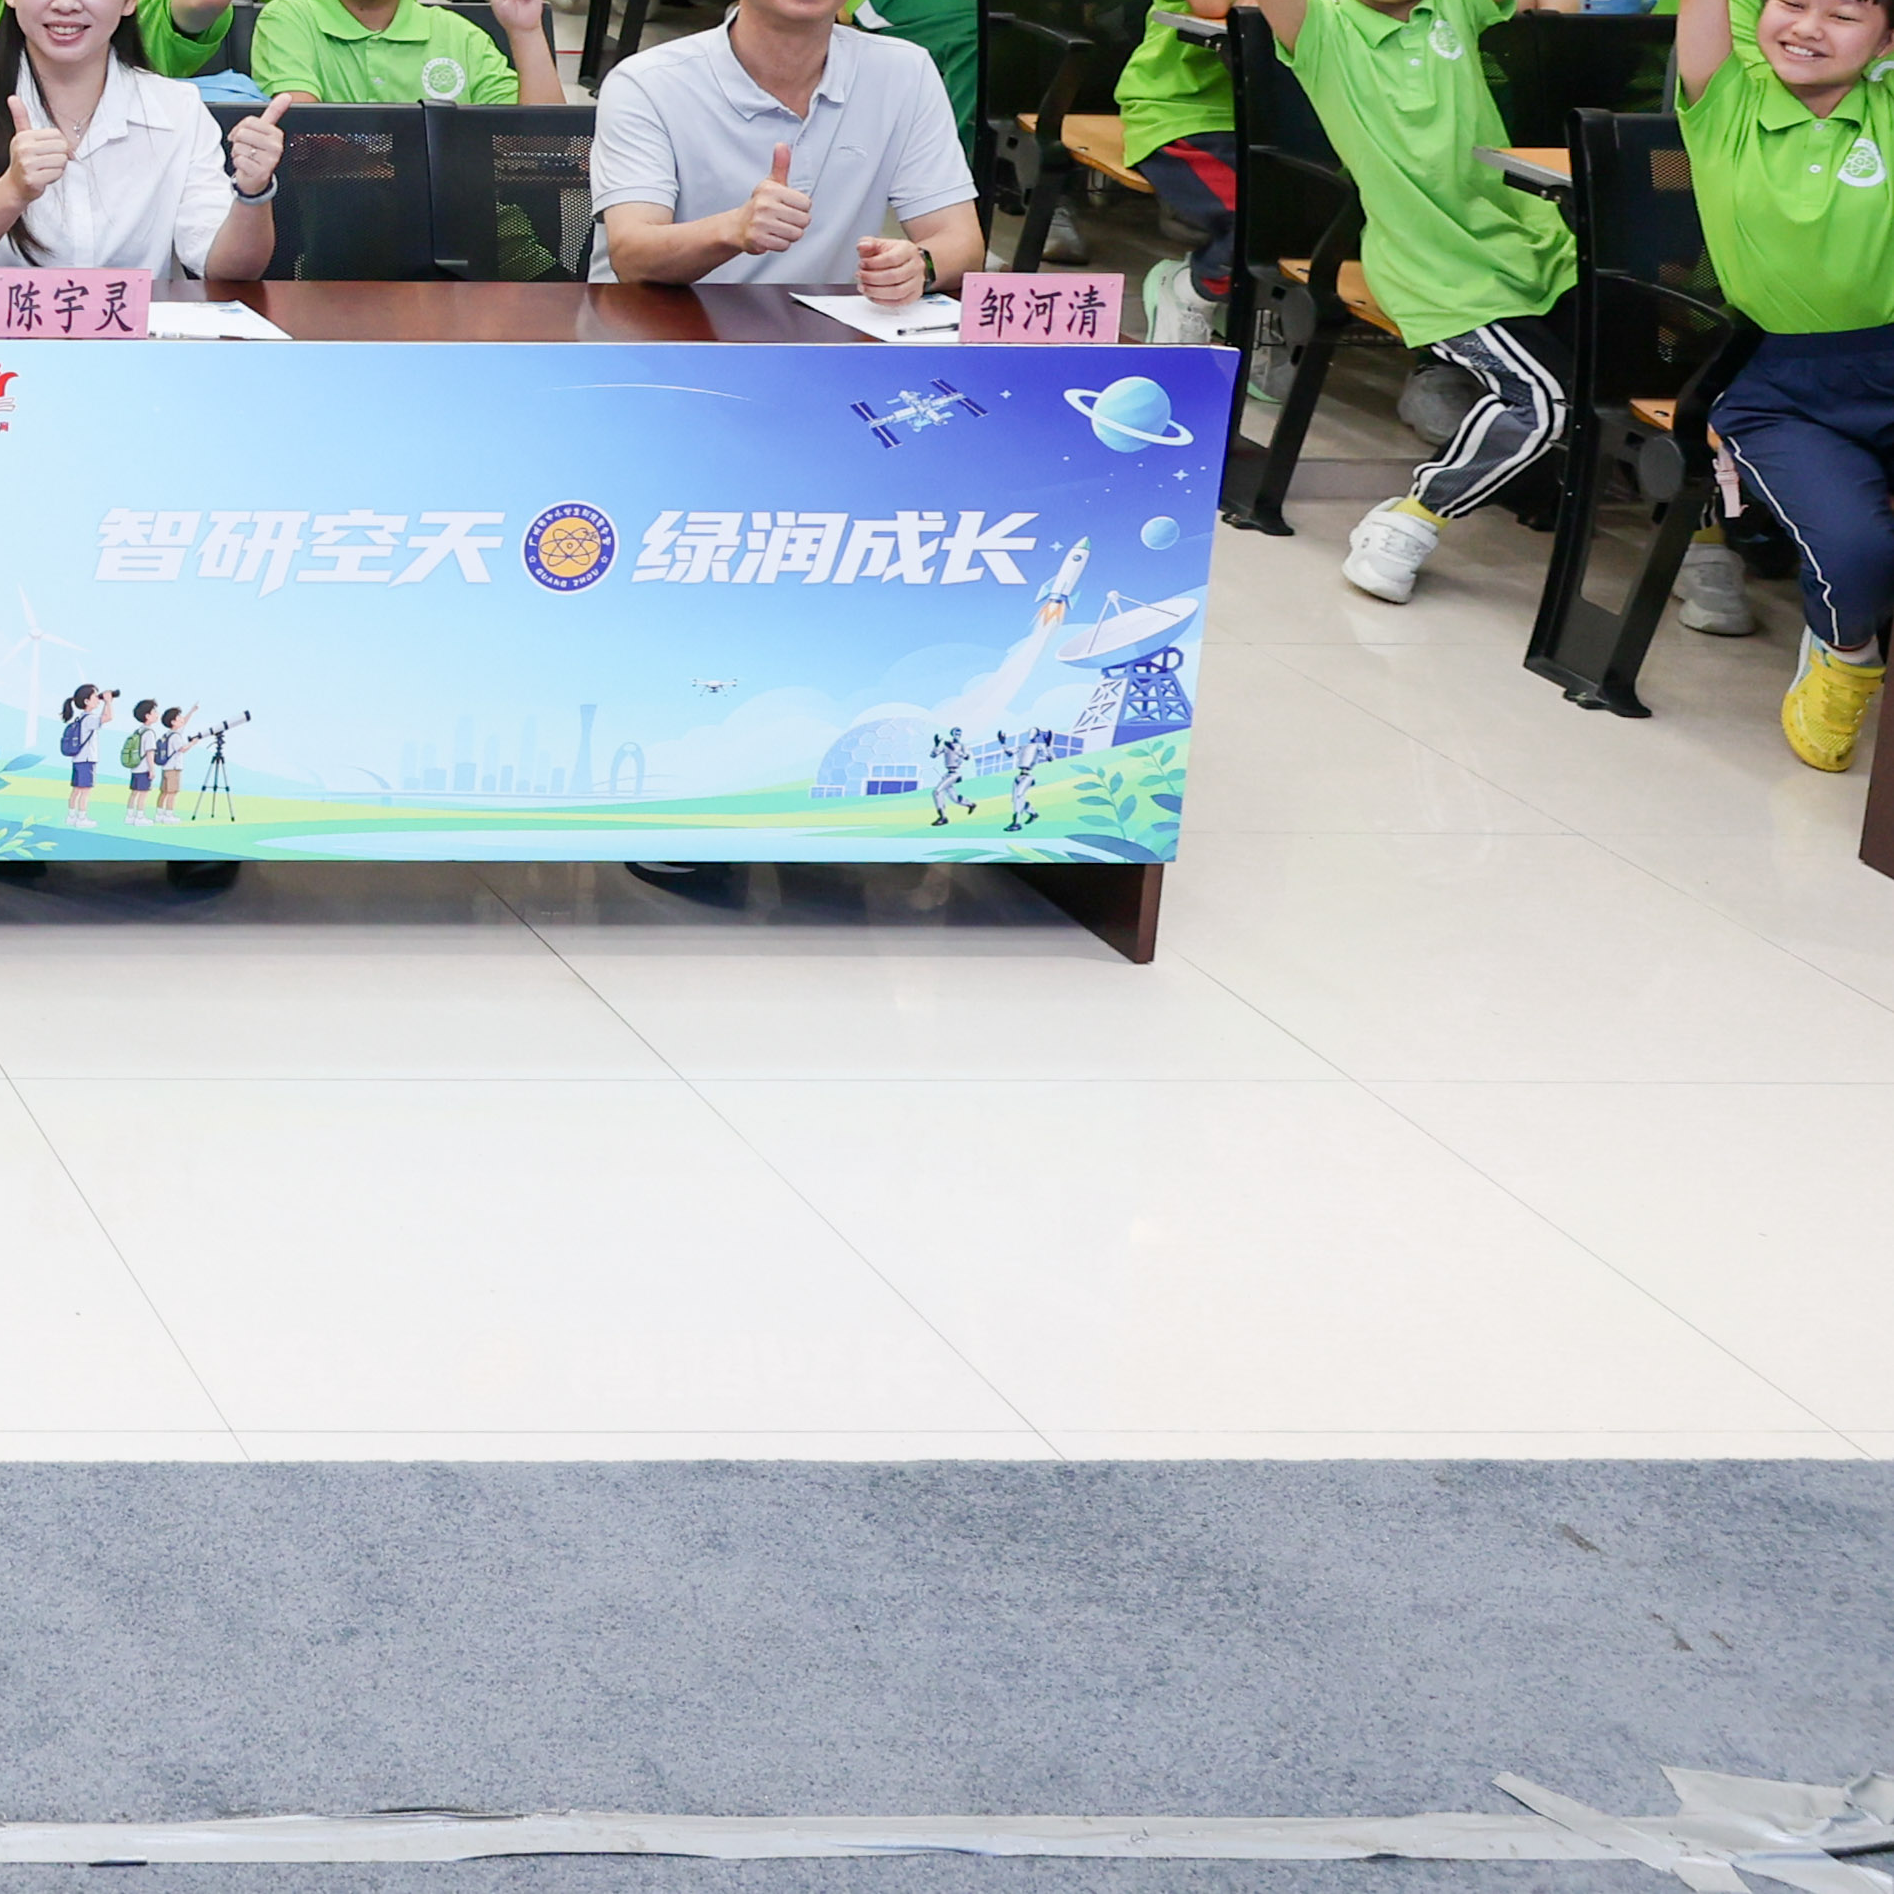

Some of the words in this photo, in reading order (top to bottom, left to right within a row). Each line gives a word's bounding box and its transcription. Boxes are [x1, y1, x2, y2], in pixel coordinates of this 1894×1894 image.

[6, 279, 134, 334] 陈宇灵
[978, 284, 1107, 339] 邹河清
[93, 508, 506, 596] 智研空天
[632, 509, 1035, 588] 绿润成长
